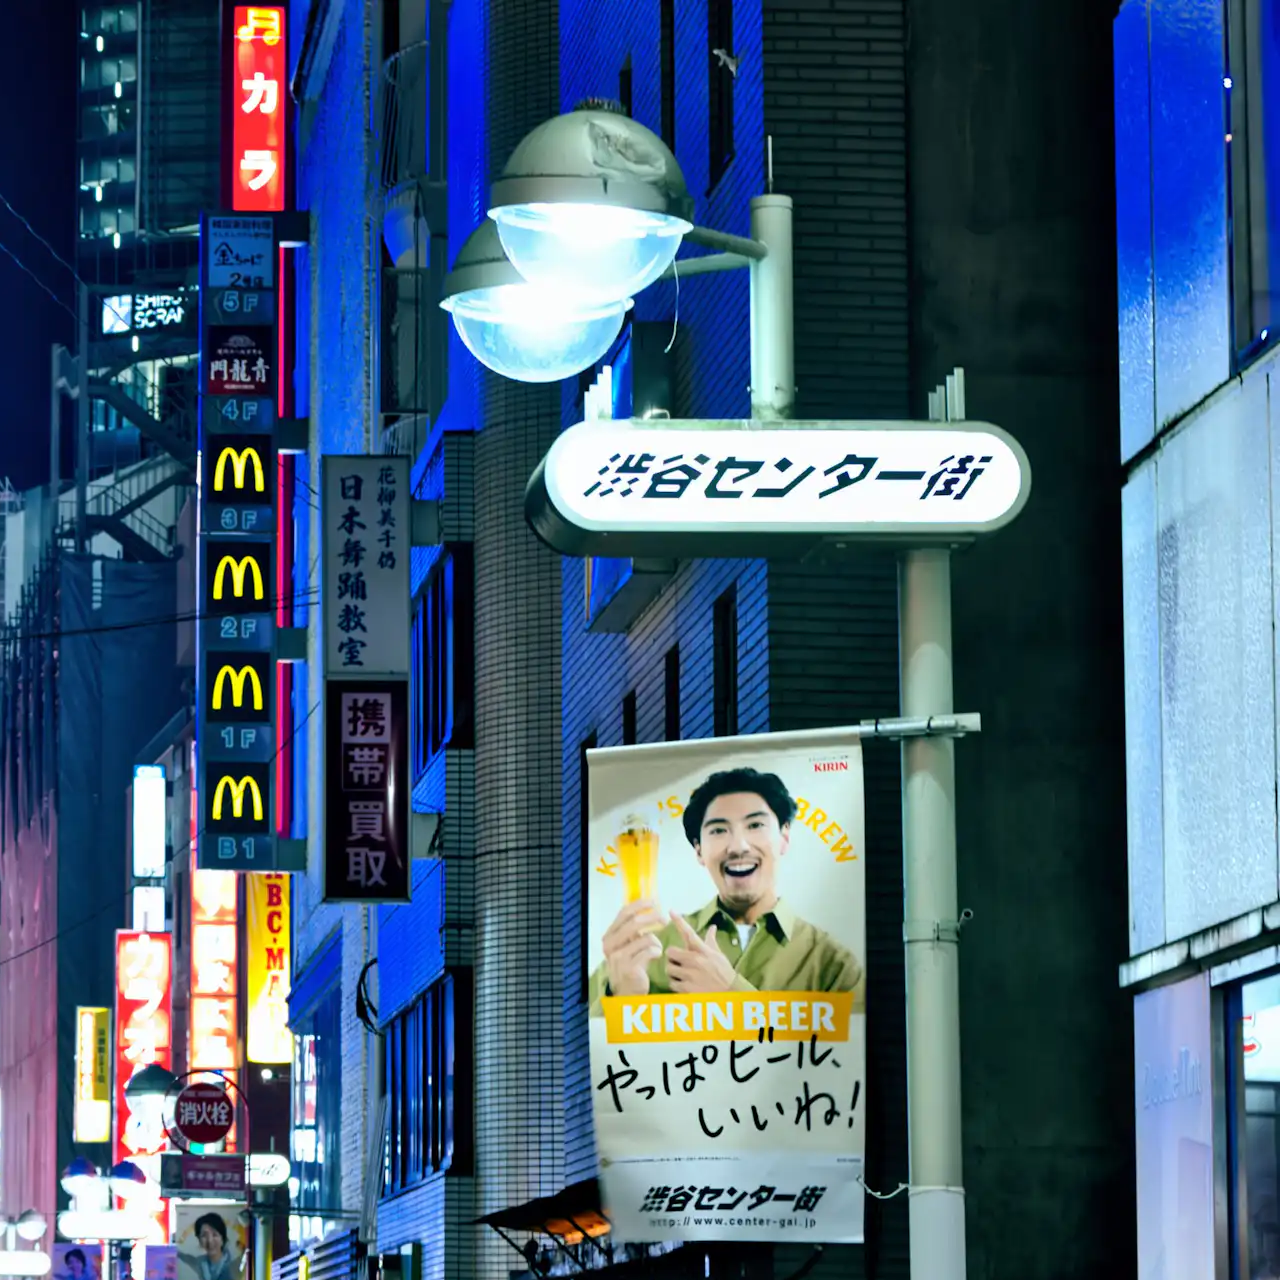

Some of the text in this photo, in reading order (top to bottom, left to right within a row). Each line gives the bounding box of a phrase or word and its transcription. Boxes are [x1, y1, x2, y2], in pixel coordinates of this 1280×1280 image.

[223, 291, 258, 312] 5F
[222, 399, 257, 420] 4F
[584, 453, 992, 501] 渋谷センター街
[221, 508, 256, 529] 3F
[337, 474, 368, 667] 日本舞踊教室
[221, 617, 255, 638] 2F
[222, 727, 255, 747] 1F
[814, 761, 848, 772] KIRIN
[346, 698, 388, 888] 携帯買取
[793, 797, 858, 864] BREW
[219, 836, 254, 859] B1
[622, 1001, 836, 1035] KIRIN BEER
[180, 1101, 229, 1125] 消火栓
[638, 1185, 827, 1212] 渋谷センター街
